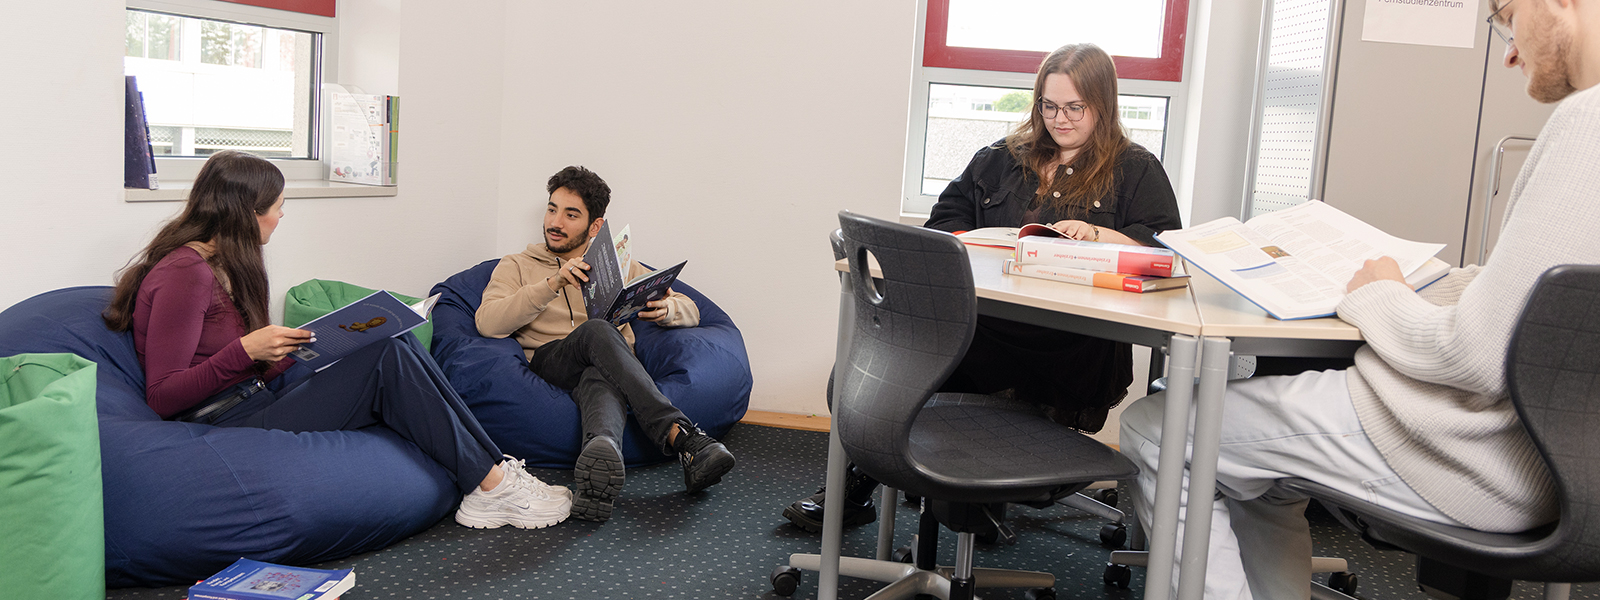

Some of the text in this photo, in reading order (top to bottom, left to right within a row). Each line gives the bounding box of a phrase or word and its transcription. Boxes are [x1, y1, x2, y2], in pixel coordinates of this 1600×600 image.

[1378, 0, 1464, 8] nstudienzentrum
[1028, 249, 1038, 258] 1
[1077, 255, 1111, 263] Erzieherinnen
[1013, 265, 1022, 273] 2
